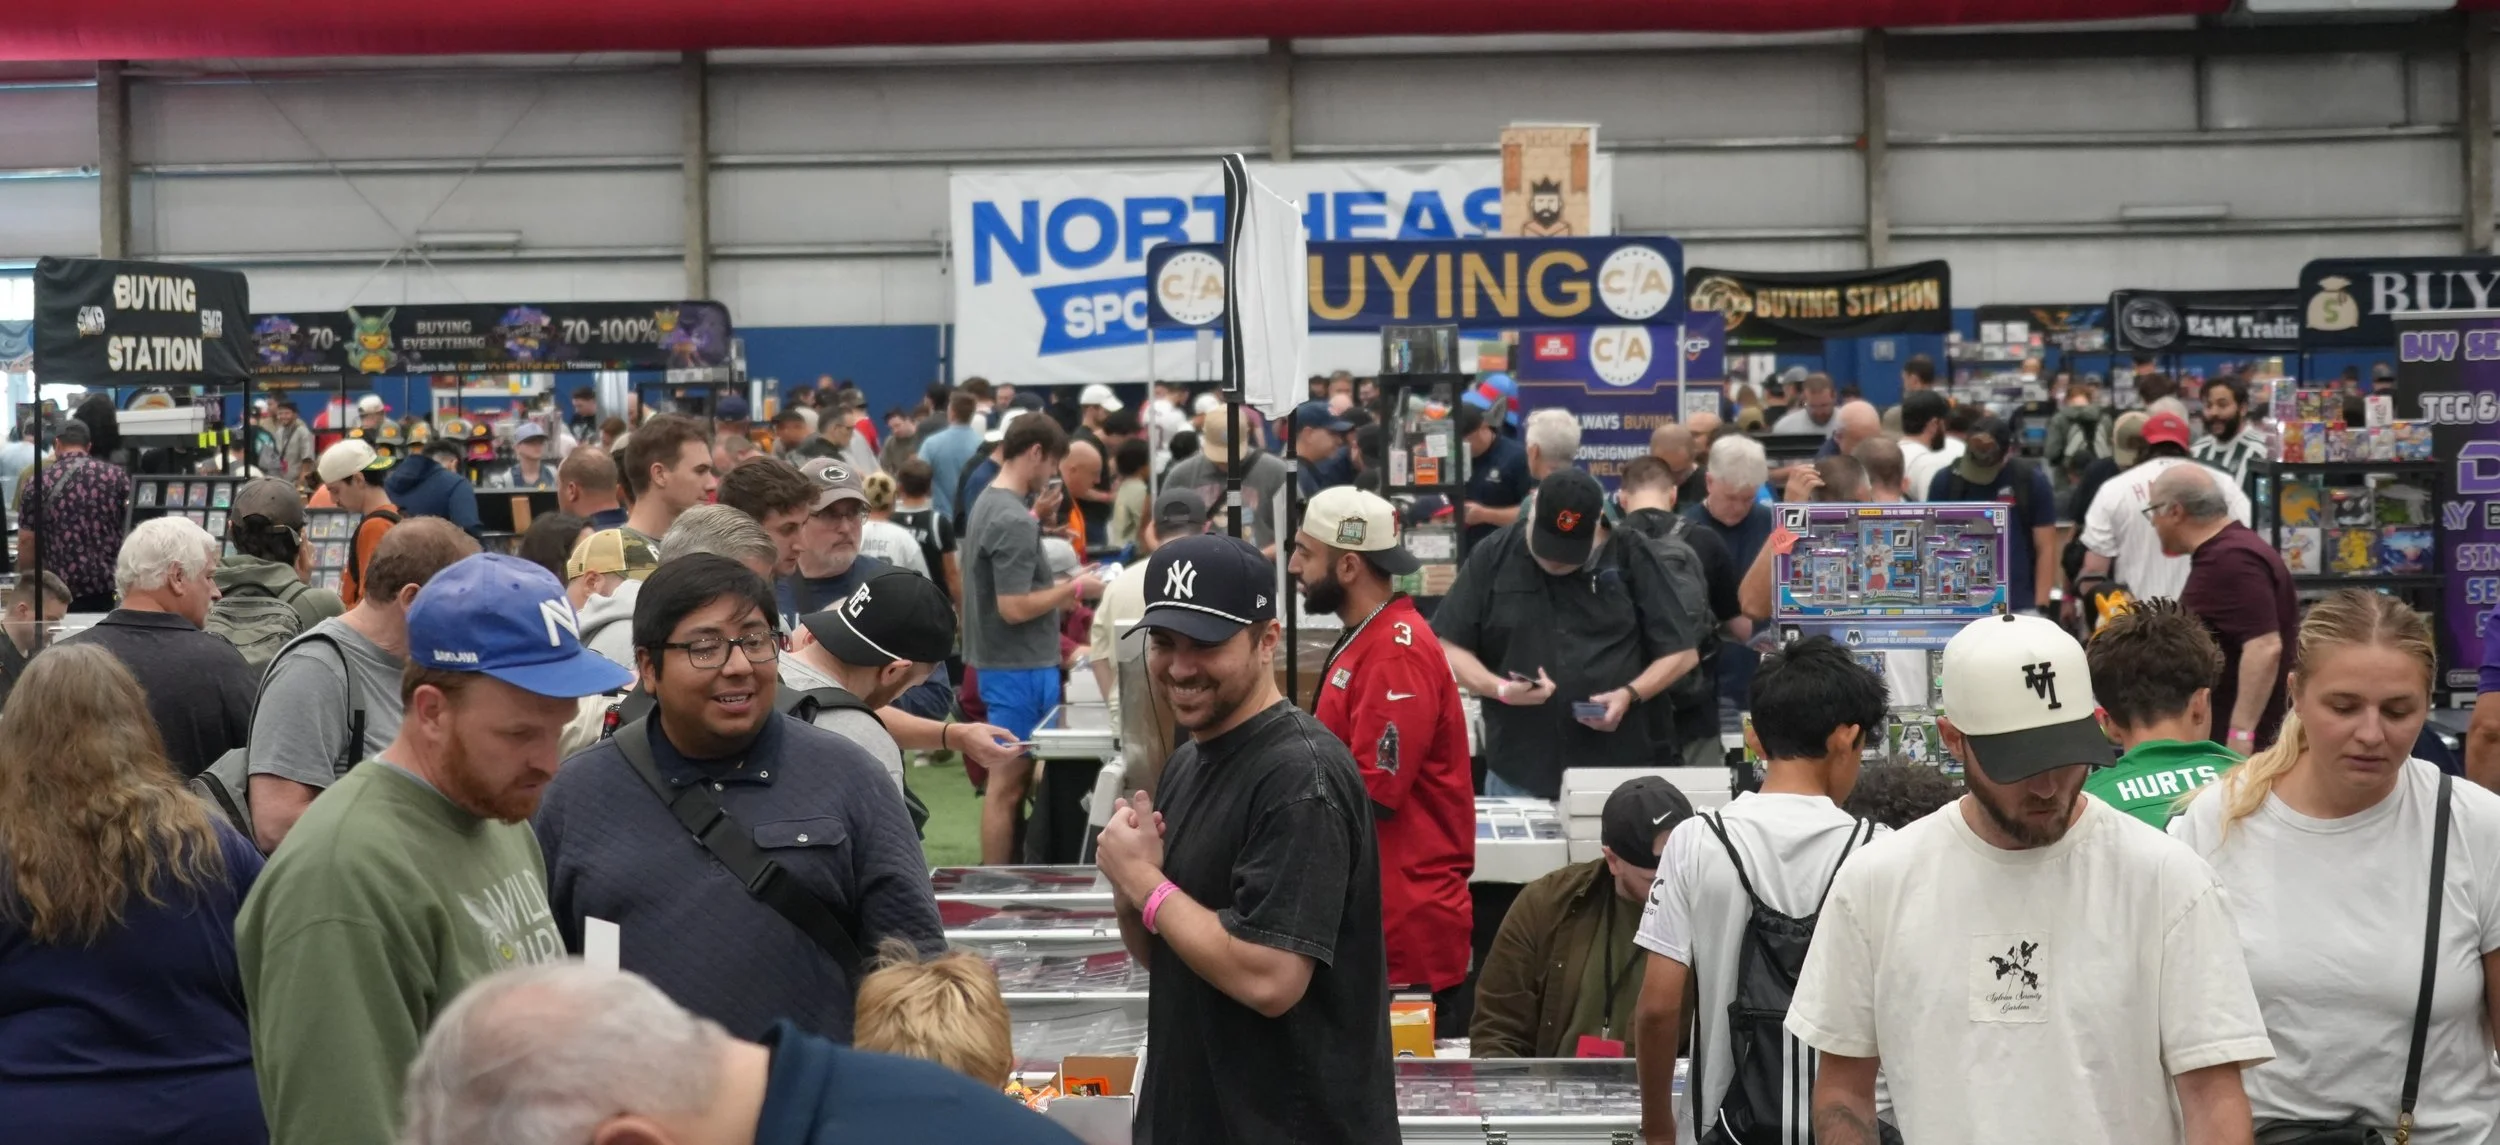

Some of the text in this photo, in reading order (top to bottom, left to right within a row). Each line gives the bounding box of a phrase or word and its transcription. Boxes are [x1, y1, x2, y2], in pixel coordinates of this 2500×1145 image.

[113, 275, 196, 312] BUYING
[1308, 250, 1592, 320] UYING
[1756, 279, 1940, 318] BUYING STATION
[416, 320, 472, 335] BUYING
[562, 319, 658, 344] 70-100%
[2186, 315, 2235, 338] E&M
[108, 336, 203, 371] STATION
[402, 336, 487, 351] EVERYTHING
[2400, 330, 2459, 362] BUY
[2420, 393, 2498, 423] TCG &
[1163, 559, 1198, 600] NY
[1393, 621, 1412, 646] 3
[2117, 765, 2220, 801] HURTS
[484, 869, 551, 936] WILD
[2000, 1002, 2030, 1014] Gardens
